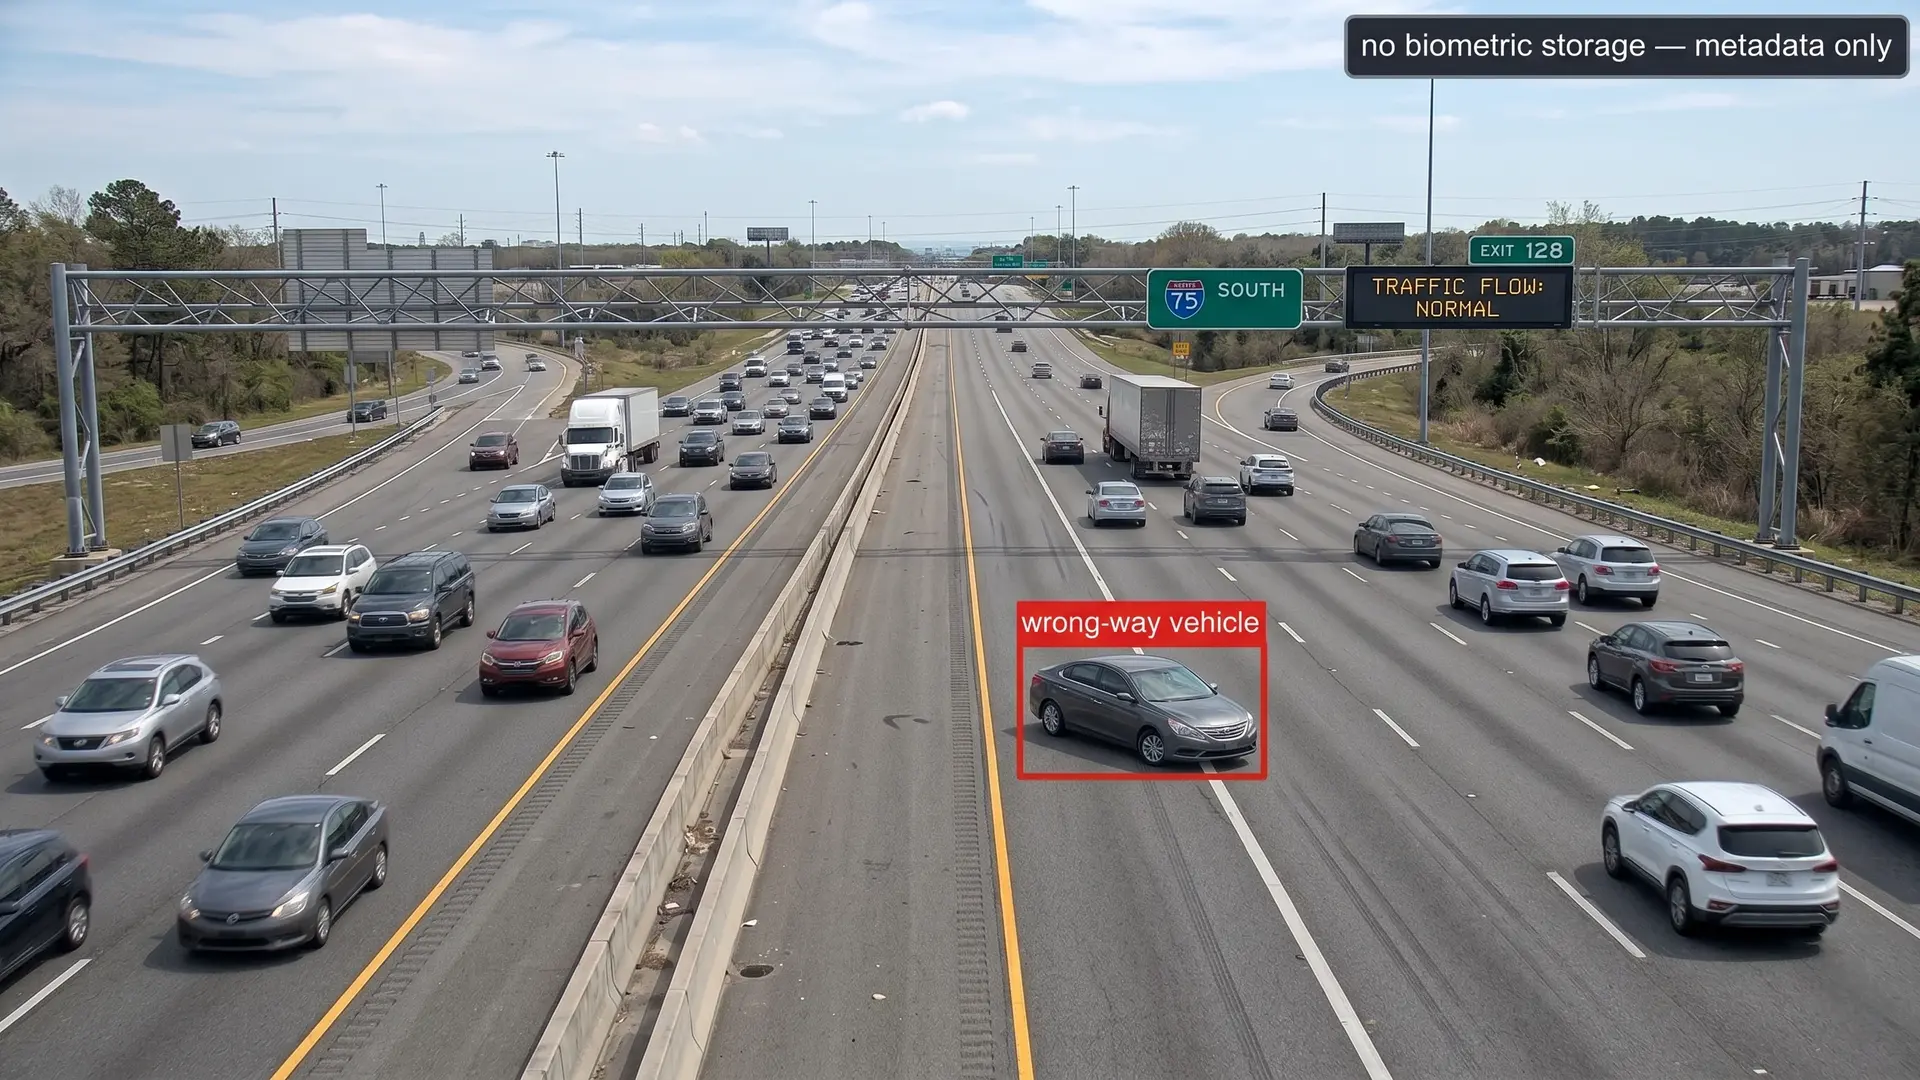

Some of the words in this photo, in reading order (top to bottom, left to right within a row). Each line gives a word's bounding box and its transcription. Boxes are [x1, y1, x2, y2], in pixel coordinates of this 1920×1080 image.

[1480, 244, 1515, 257] EXIT
[1525, 242, 1564, 259] 128
[1217, 282, 1285, 298] SOUTH
[1372, 277, 1465, 295] TRAFFIC
[1480, 277, 1544, 295] FLOW:
[1170, 292, 1198, 311] 75
[1415, 300, 1500, 318] NORMAL
